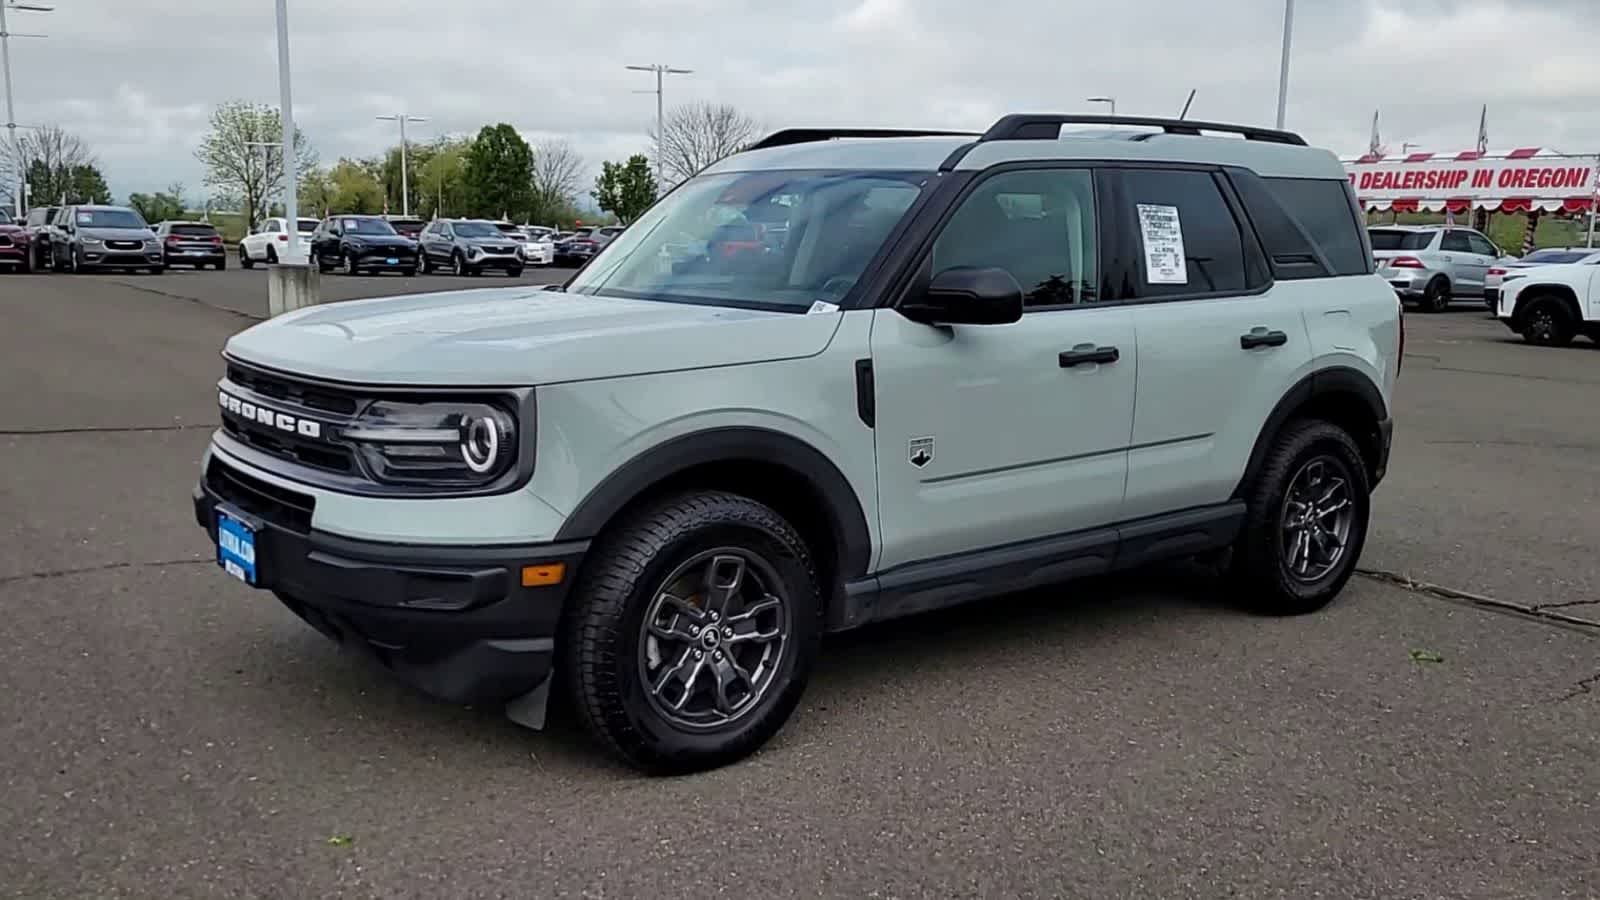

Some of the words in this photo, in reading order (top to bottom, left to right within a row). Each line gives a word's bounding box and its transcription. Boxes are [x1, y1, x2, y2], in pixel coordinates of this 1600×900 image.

[1360, 169, 1468, 189] DEALERSHIP
[1471, 168, 1494, 188] IN
[1498, 167, 1590, 188] OREGON!
[219, 391, 320, 438] BRONCO
